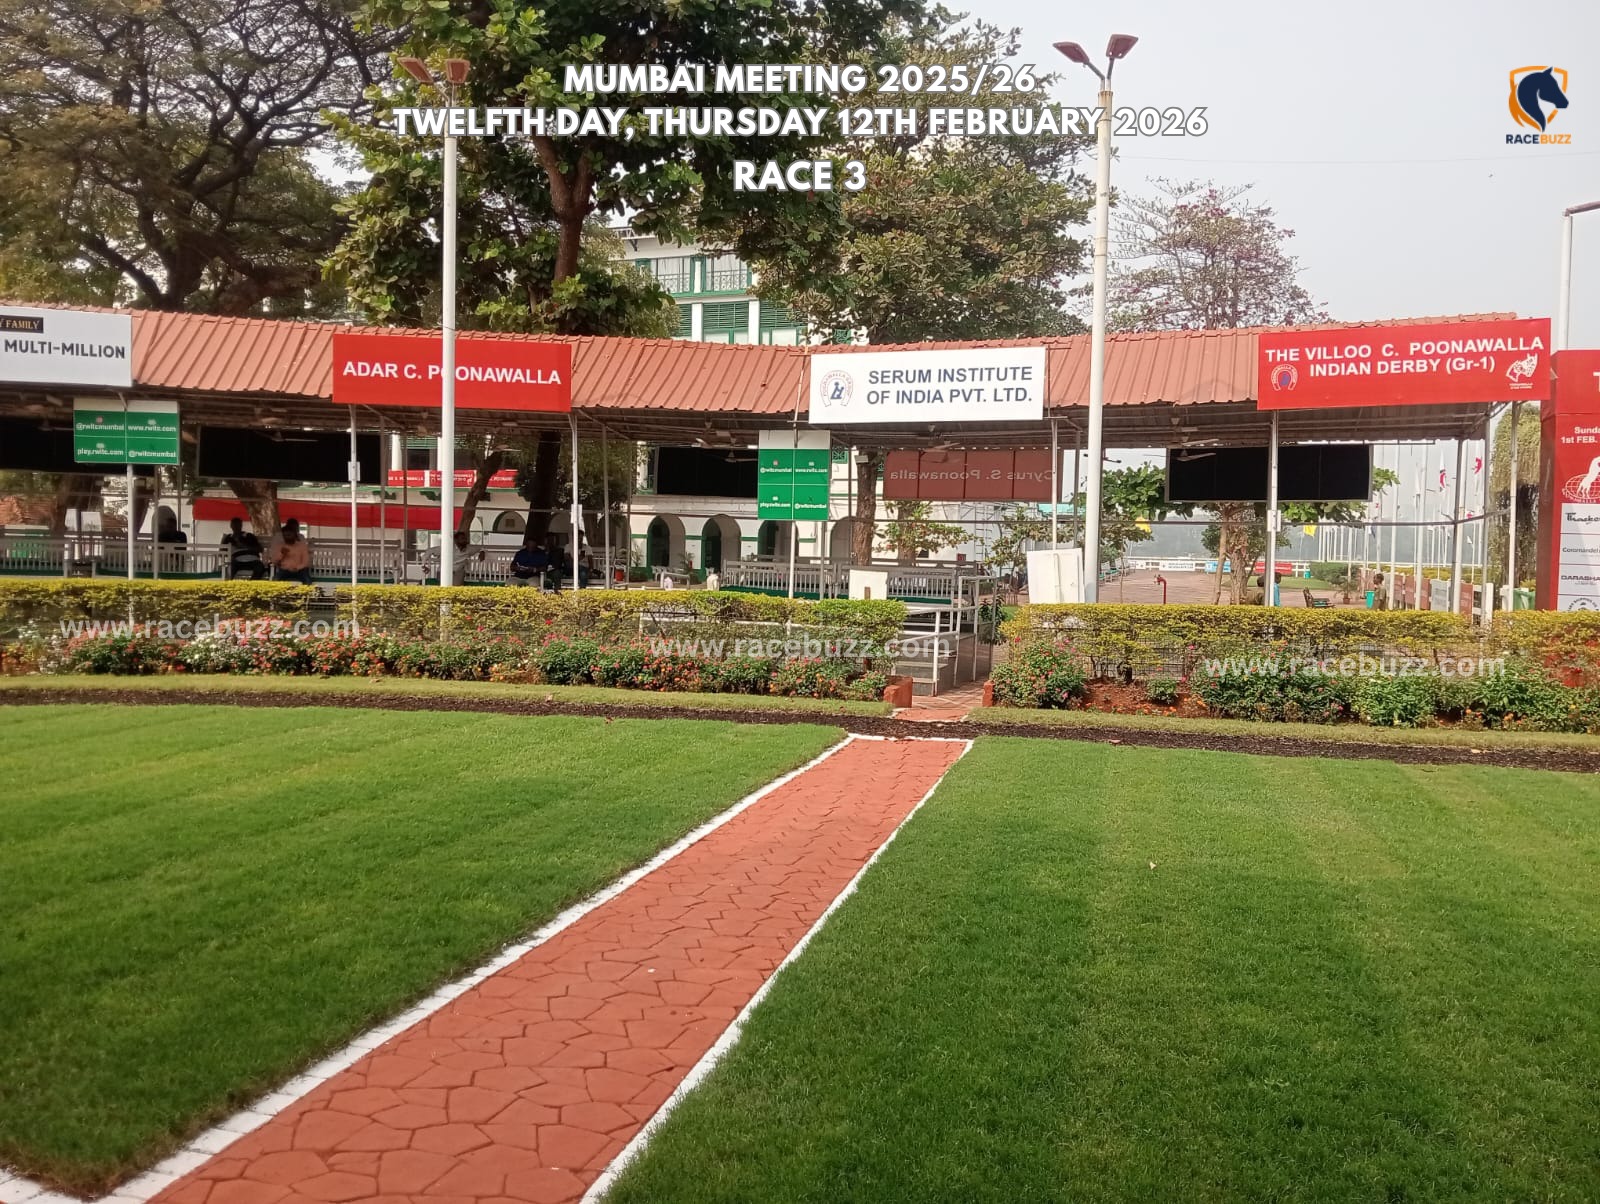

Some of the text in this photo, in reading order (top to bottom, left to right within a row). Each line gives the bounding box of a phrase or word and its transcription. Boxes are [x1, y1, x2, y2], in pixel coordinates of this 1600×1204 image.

[6, 319, 40, 330] FAMILY
[4, 339, 125, 359] MULTI-MILLION
[1265, 336, 1545, 363] THE VILLOO C. POONAWALLA
[342, 361, 562, 385] ADAR C. PONAWALLA
[868, 366, 1033, 385] SERUM INSTITUTE
[1310, 355, 1496, 377] INDIAN DERBY (Gr-1)
[867, 387, 1033, 405] OF INDIA PVT. LTD.
[1561, 435, 1598, 444] 1st FEB.
